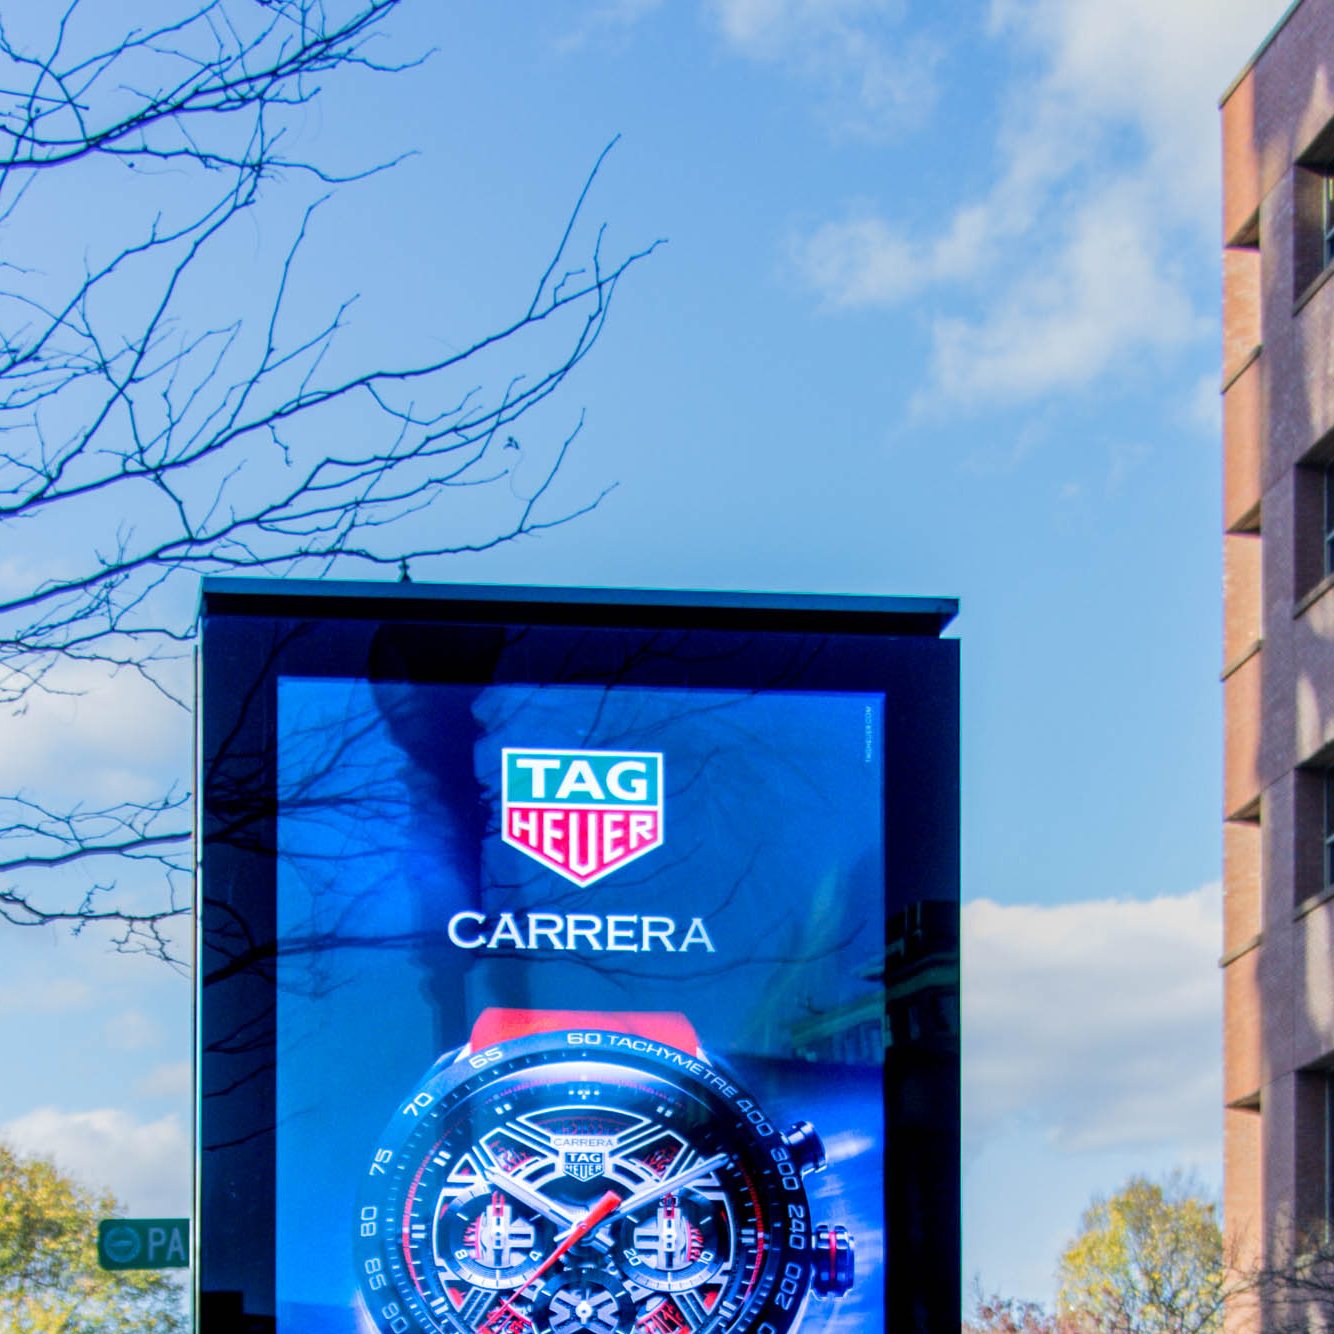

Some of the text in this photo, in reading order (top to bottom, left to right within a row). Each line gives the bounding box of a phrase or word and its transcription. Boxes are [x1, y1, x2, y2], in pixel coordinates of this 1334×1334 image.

[517, 759, 647, 800] TAG
[512, 810, 652, 876] HEUER
[448, 911, 715, 952] CARRERA
[469, 1047, 503, 1069] 65
[567, 1033, 773, 1137] 60 TACHYMETRE 400
[403, 1092, 433, 1117] 70
[553, 1138, 614, 1147] CARRERA
[568, 1153, 601, 1162] TAG
[369, 1148, 393, 1176] 75
[566, 1164, 602, 1179] HEUER
[360, 1206, 377, 1237] 80
[149, 1227, 186, 1261] PA
[623, 1248, 642, 1266] 20
[365, 1257, 387, 1290] 85
[382, 1303, 408, 1334] 90
